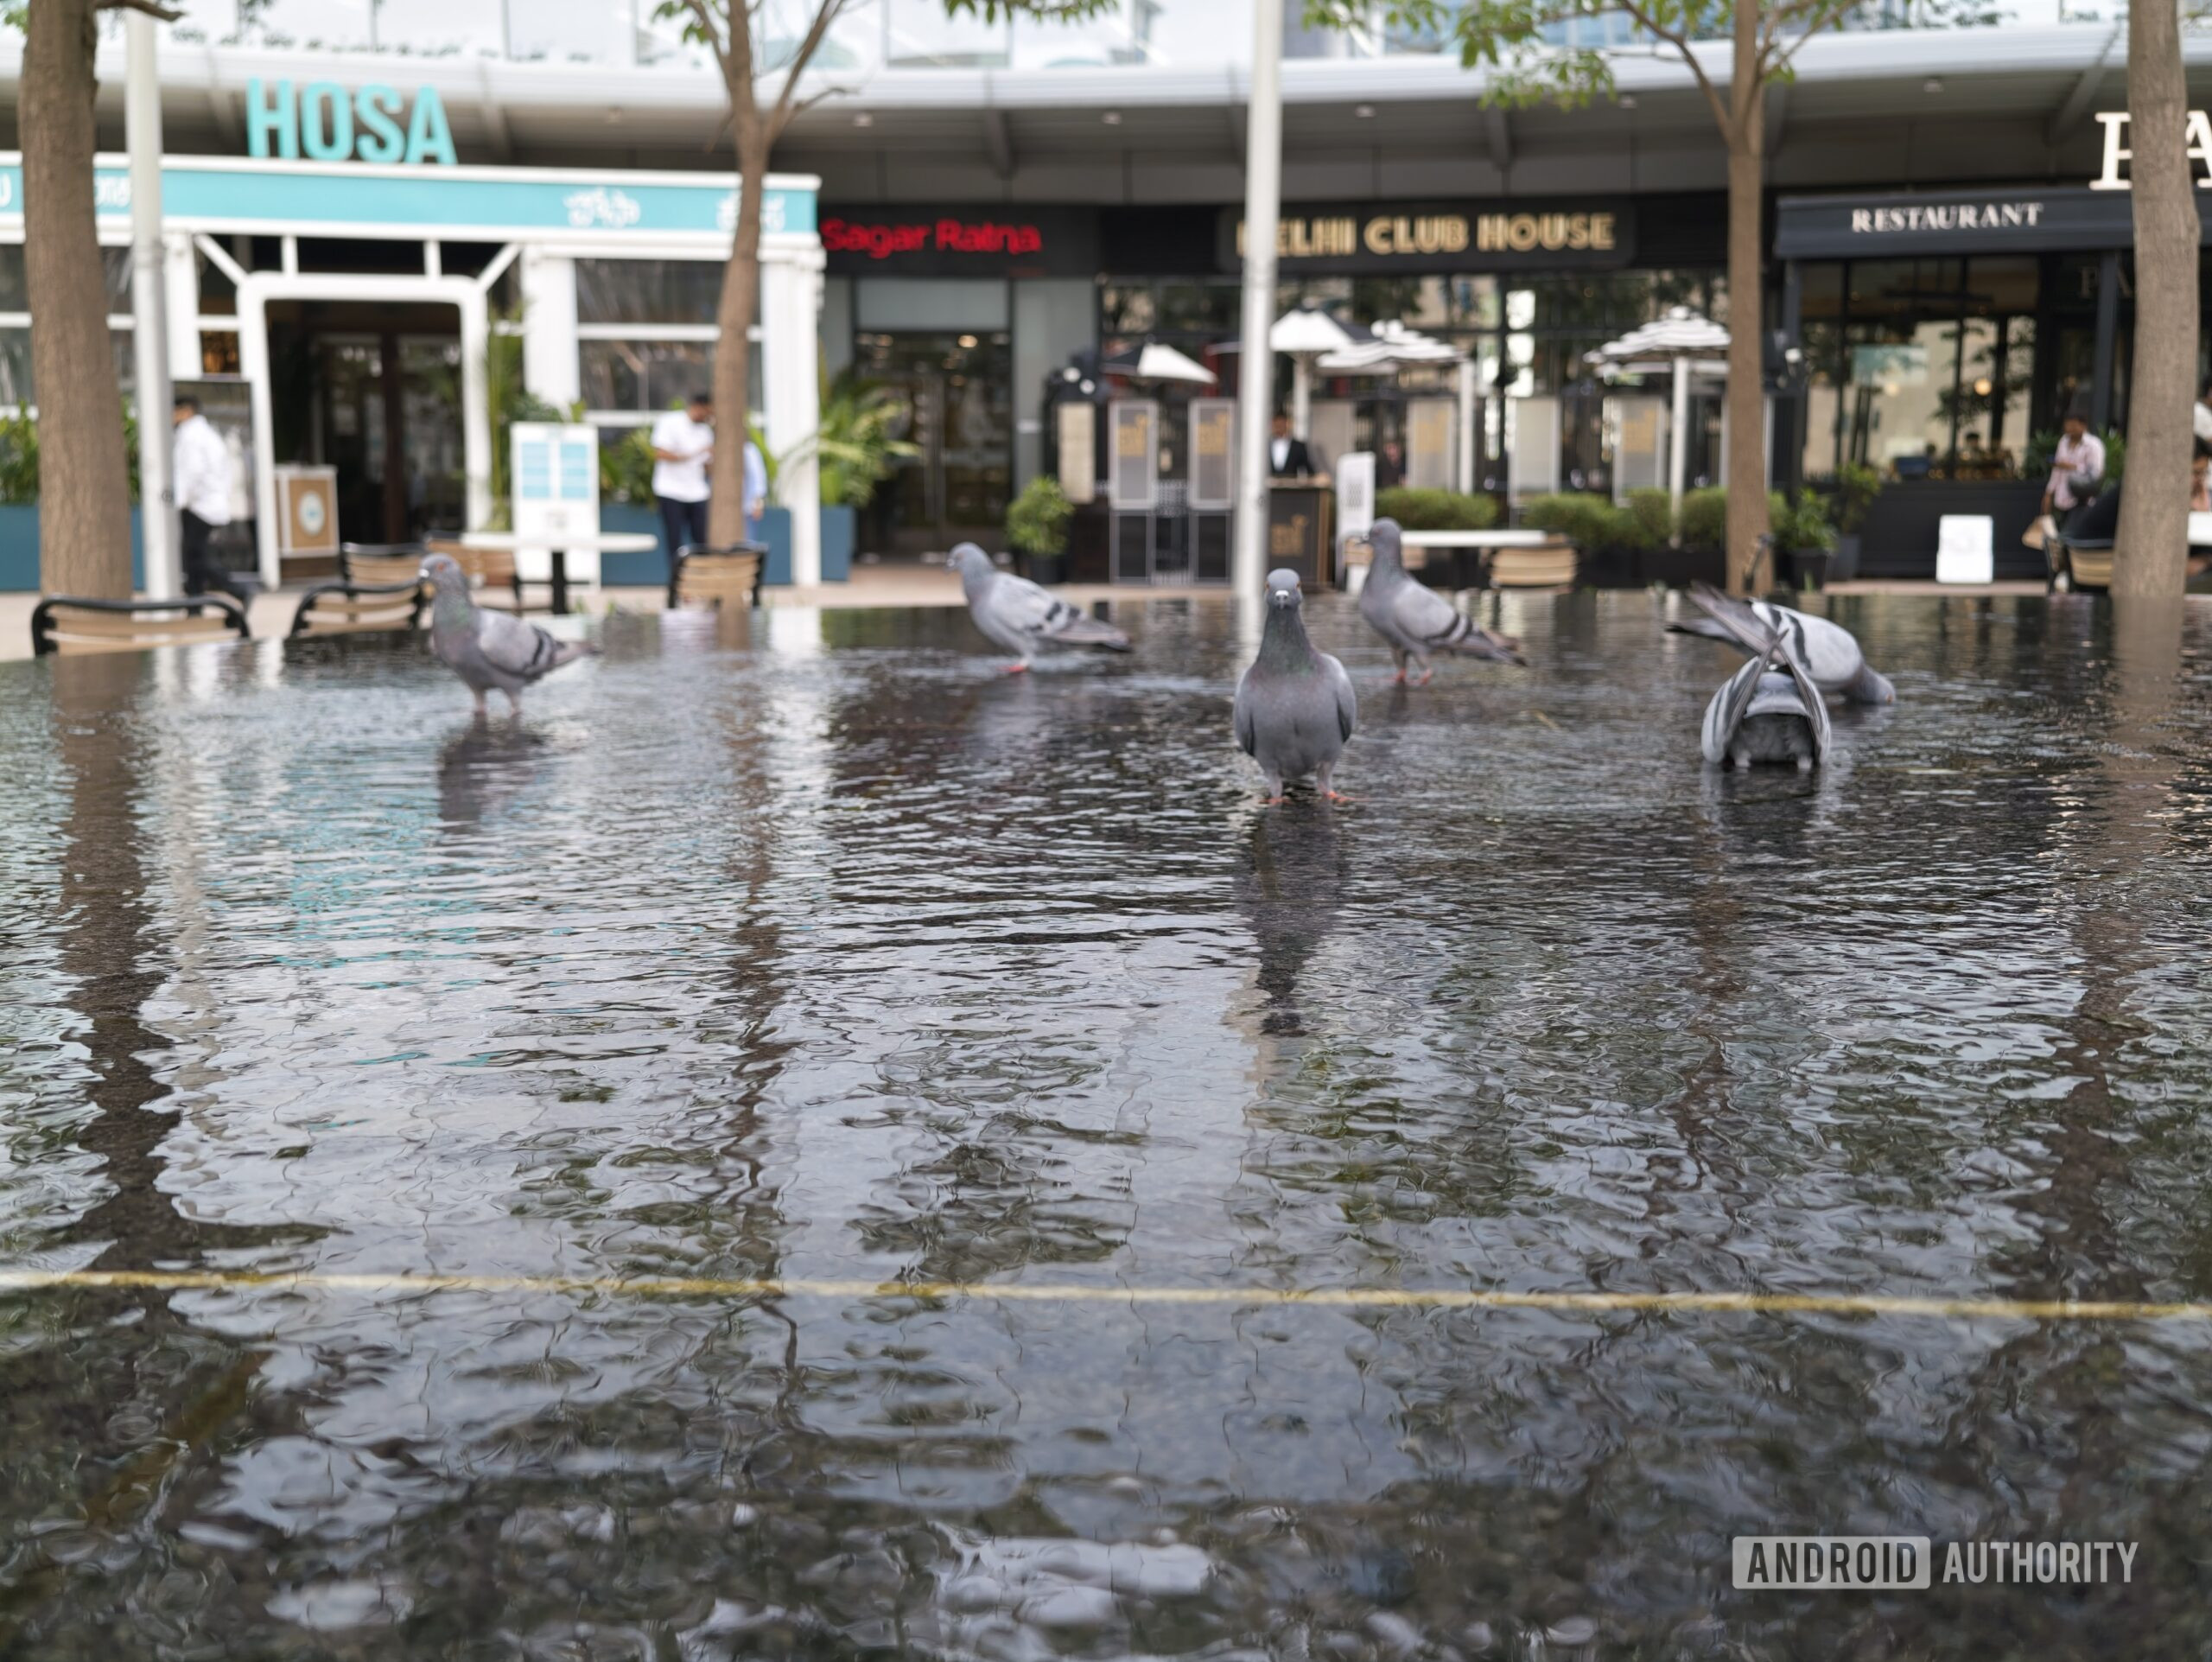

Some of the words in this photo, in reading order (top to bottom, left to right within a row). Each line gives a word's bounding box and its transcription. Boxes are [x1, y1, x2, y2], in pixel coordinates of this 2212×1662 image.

[247, 78, 458, 165] HOSA
[1363, 215, 1469, 255] CLUB
[1477, 213, 1617, 252] HOUSE
[1851, 202, 2043, 233] RESTAURANT
[821, 219, 931, 258] Sagar
[936, 219, 1042, 255] Ratna
